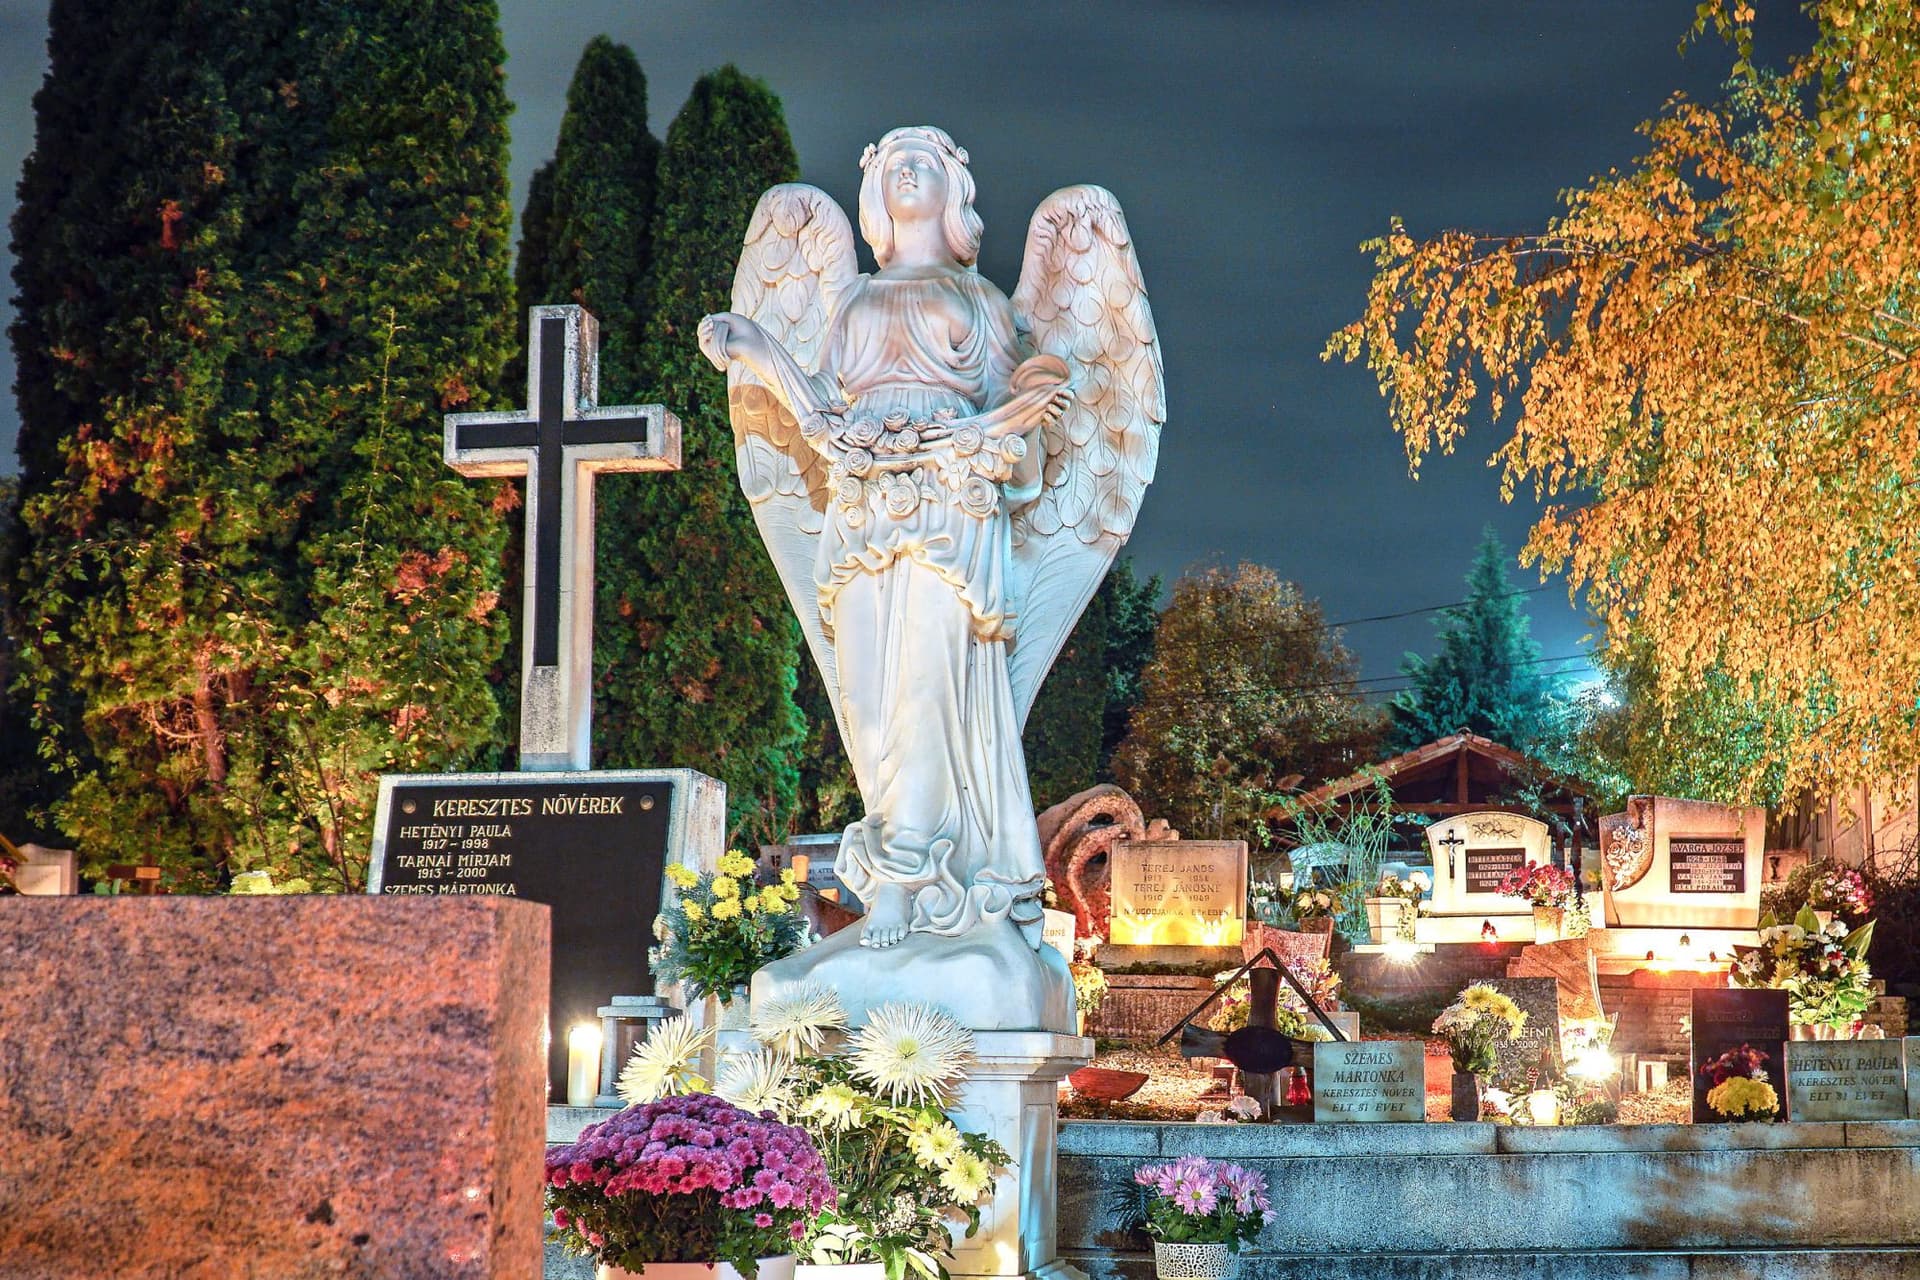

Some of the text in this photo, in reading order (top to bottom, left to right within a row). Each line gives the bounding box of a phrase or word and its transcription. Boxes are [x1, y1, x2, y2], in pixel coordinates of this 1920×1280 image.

[432, 793, 624, 817] KERESZTES NŐVÉREK
[399, 824, 511, 838] HETÉNYI PAULA
[422, 838, 448, 850] 1917
[461, 838, 489, 849] 1998
[417, 868, 441, 879] 1913
[456, 867, 486, 878] 2000
[1141, 863, 1175, 873] TEREJ
[1133, 883, 1166, 892] TEREJ
[1518, 1040, 1539, 1048] 2002
[1344, 1052, 1394, 1065] SZEMES
[1797, 1077, 1856, 1087] KERESZTES
[1322, 1088, 1378, 1098] KERESZTES
